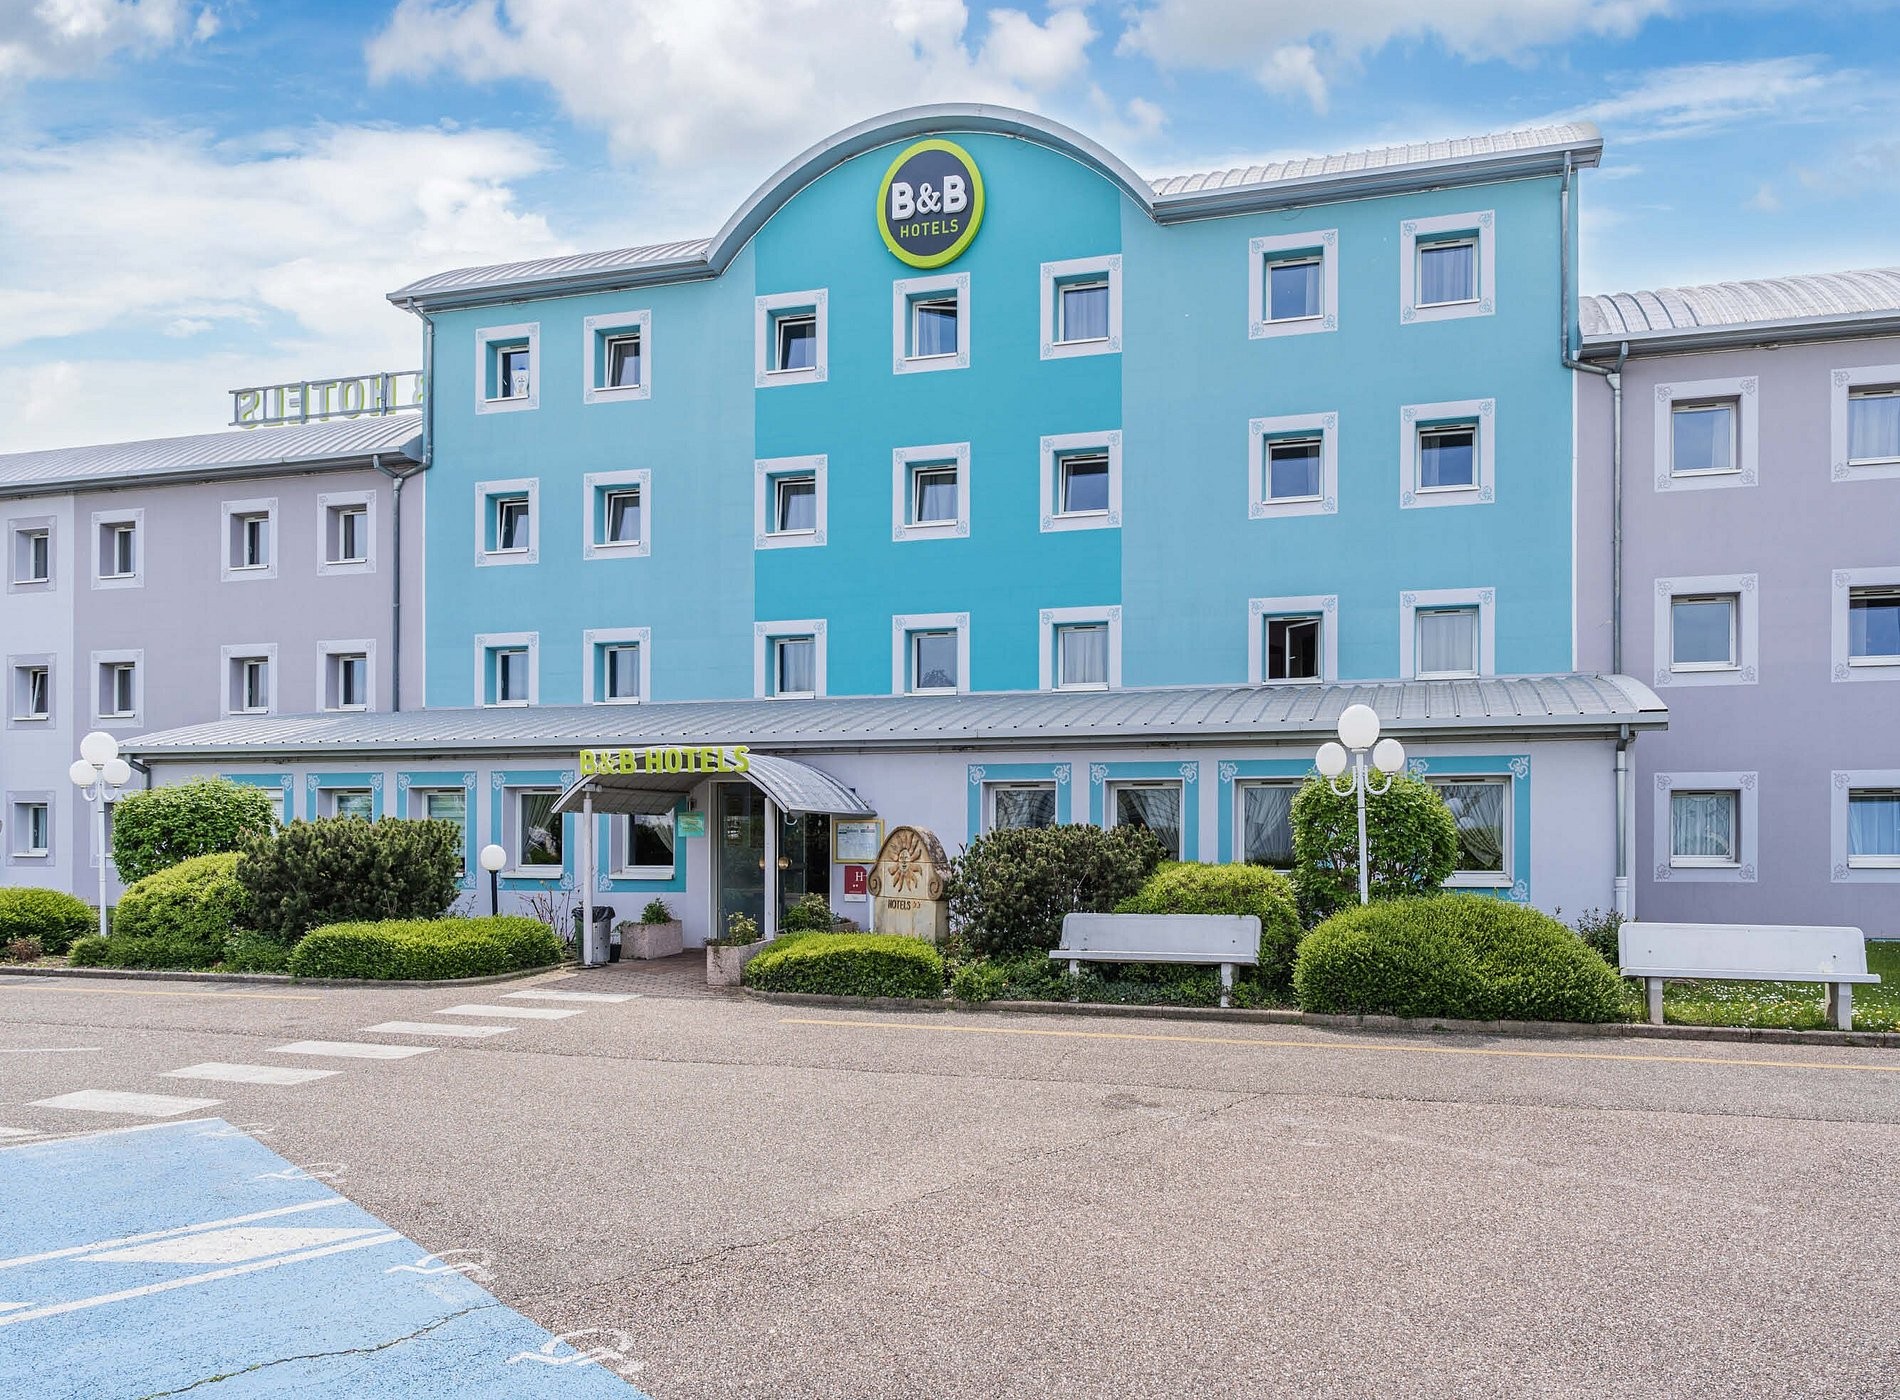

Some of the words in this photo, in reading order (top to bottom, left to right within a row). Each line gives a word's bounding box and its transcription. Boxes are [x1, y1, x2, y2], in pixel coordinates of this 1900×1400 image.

[892, 174, 968, 221] B&B
[900, 219, 958, 238] HOTELS
[579, 749, 637, 775] B&B
[645, 745, 750, 774] HOTELS
[855, 871, 863, 882] H
[887, 899, 911, 910] HOTELS
